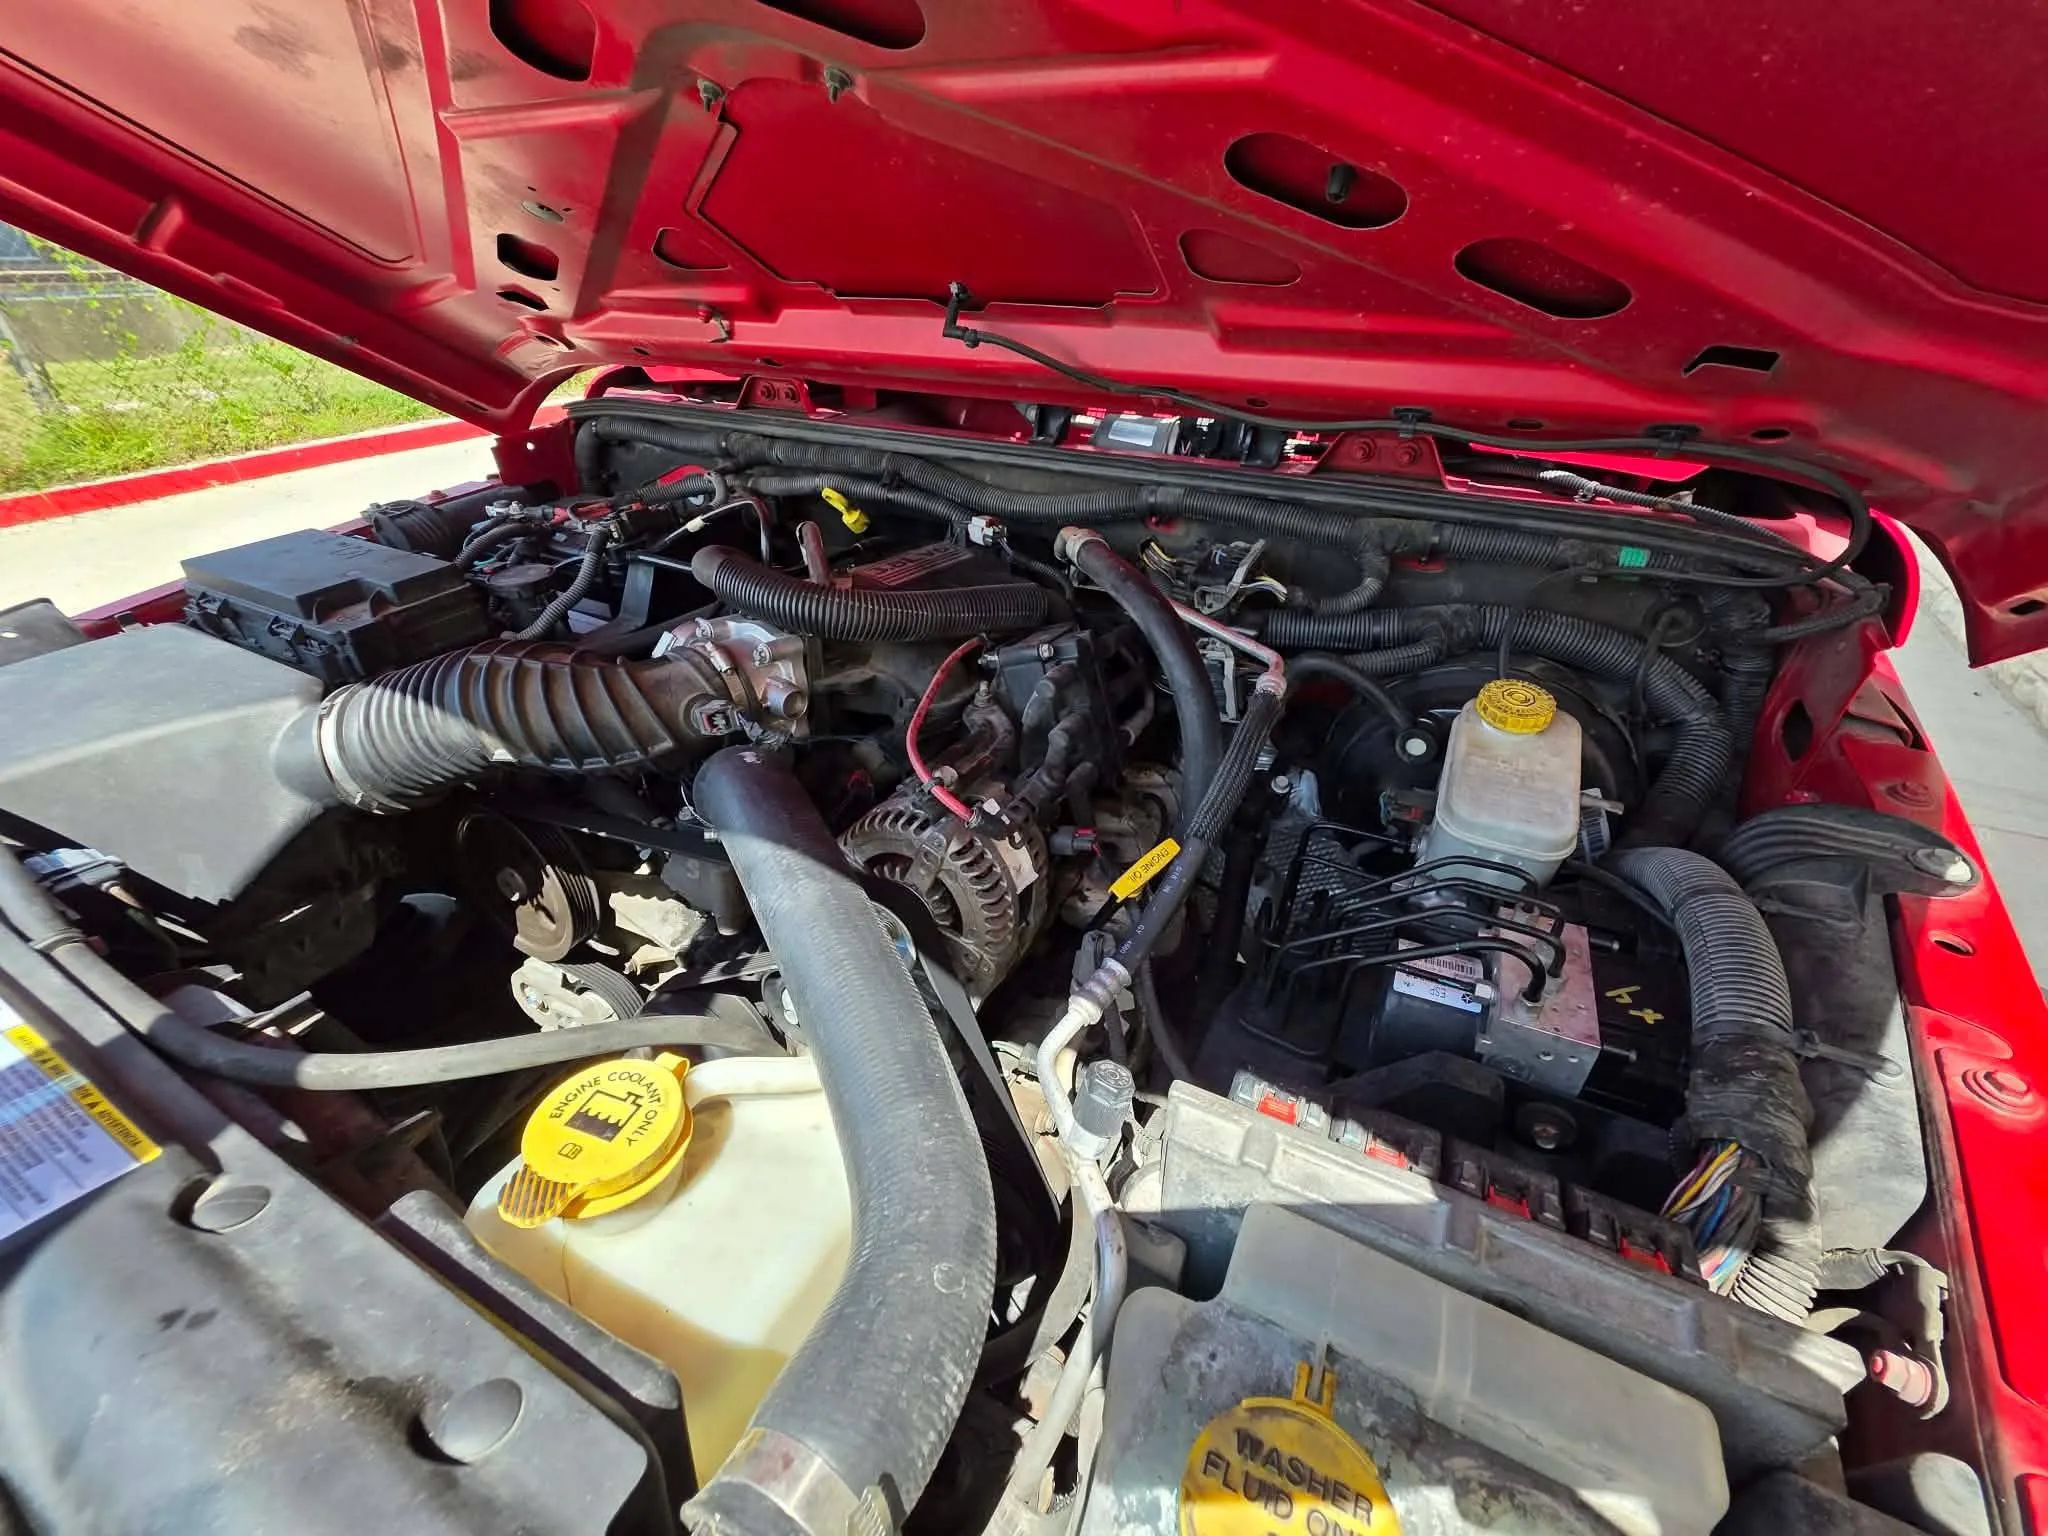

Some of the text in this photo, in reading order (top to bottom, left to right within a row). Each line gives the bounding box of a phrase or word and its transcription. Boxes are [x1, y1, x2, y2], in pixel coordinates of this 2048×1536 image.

[1128, 870, 1143, 882] OIL
[1144, 847, 1169, 873] ENGINE
[550, 1071, 663, 1147] ENGINE COOLANT ONLY
[1202, 1450, 1294, 1519] FLUID
[1234, 1427, 1373, 1527] WASHER
